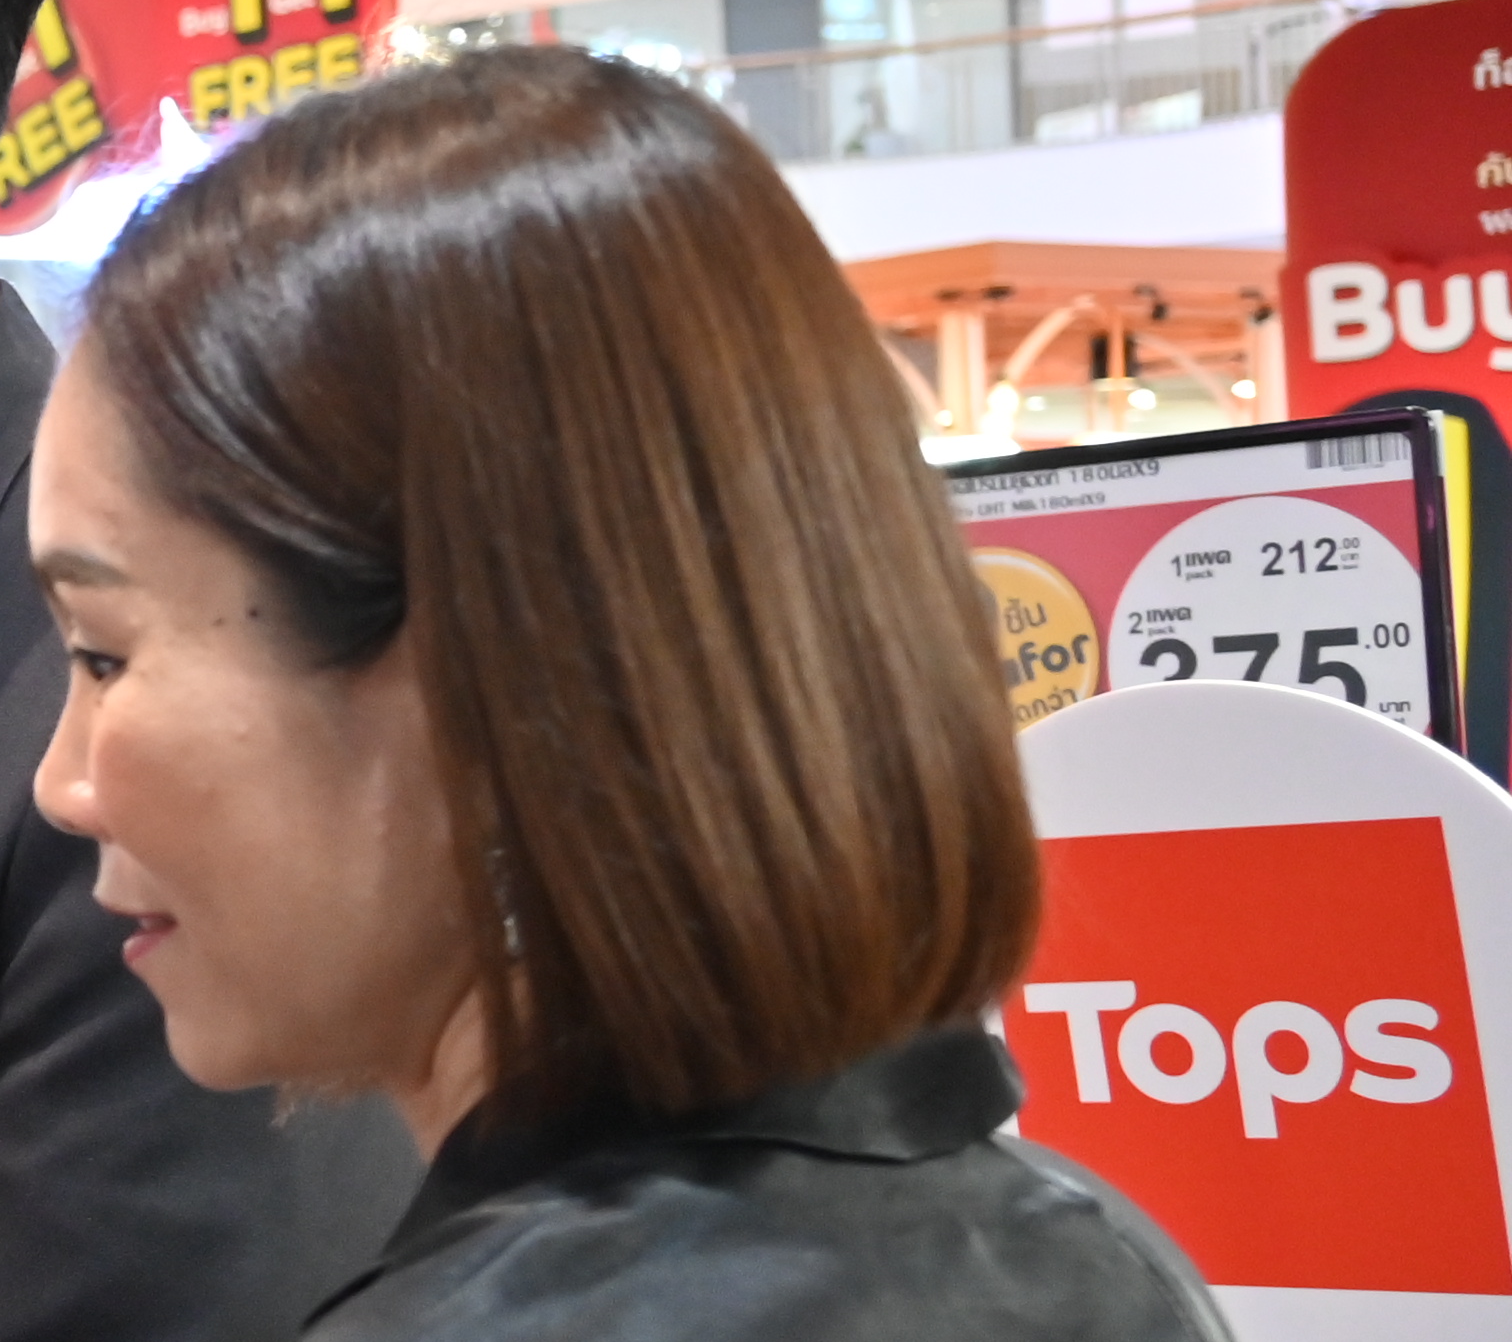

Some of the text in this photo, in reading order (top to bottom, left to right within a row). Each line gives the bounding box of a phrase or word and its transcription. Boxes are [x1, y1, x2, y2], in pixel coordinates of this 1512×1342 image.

[189, 33, 364, 129] FREE
[1260, 537, 1339, 577] 212
[1024, 977, 1454, 1141] Tops
